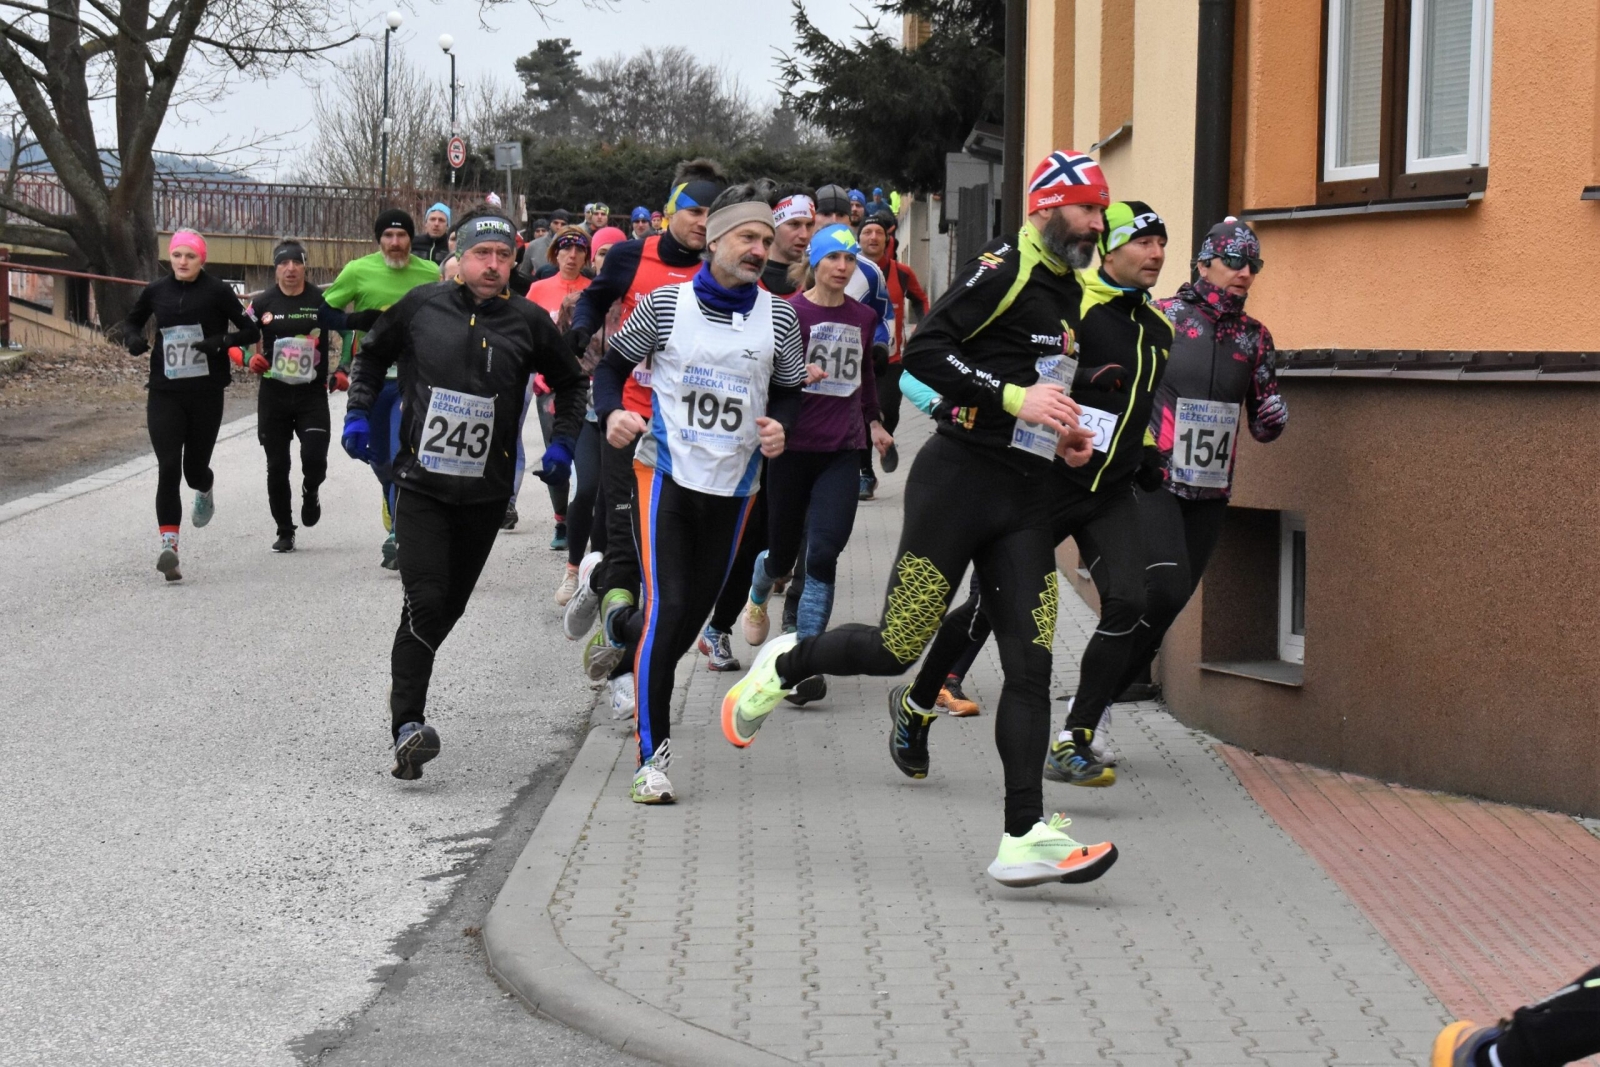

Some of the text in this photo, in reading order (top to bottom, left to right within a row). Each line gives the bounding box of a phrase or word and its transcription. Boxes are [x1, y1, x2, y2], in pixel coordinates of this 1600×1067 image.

[965, 265, 988, 288] smart
[844, 336, 859, 345] LIGA
[1031, 333, 1063, 347] smart
[166, 343, 206, 367] 672
[275, 350, 312, 376] 659
[810, 343, 859, 381] 615
[684, 365, 714, 377] ZIMNÍ
[682, 374, 749, 395] BĚŽECKÁ LIGA
[434, 391, 462, 404] ZIMNÍ
[1181, 402, 1209, 412] ZIMNÍ
[431, 402, 494, 419] BĚŽECKÁ LIGA
[682, 390, 743, 433] 195
[1179, 412, 1236, 425] BĚŽECKÁ LIGA
[423, 415, 490, 459] 243
[1180, 428, 1231, 469] 154
